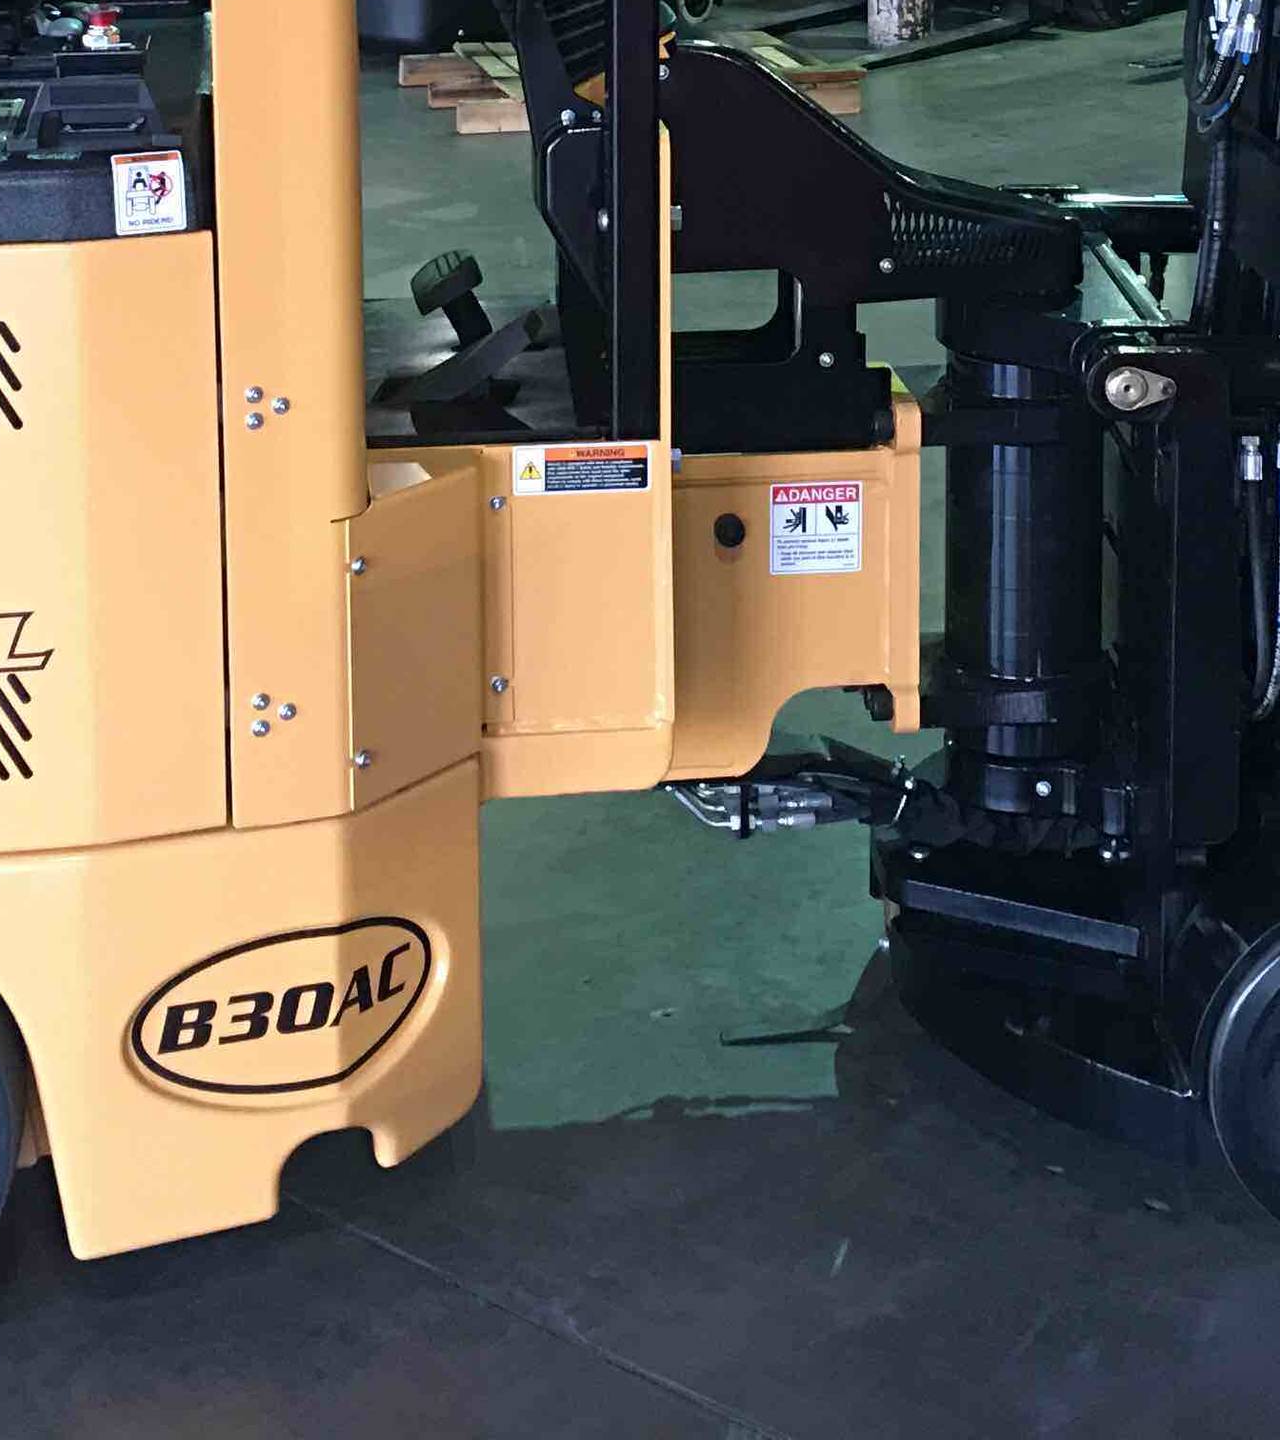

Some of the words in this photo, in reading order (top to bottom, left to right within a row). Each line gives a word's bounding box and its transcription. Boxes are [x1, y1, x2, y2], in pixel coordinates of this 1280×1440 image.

[575, 448, 626, 458] WARNING
[788, 487, 858, 503] DANGER
[157, 941, 412, 1055] B30AC
